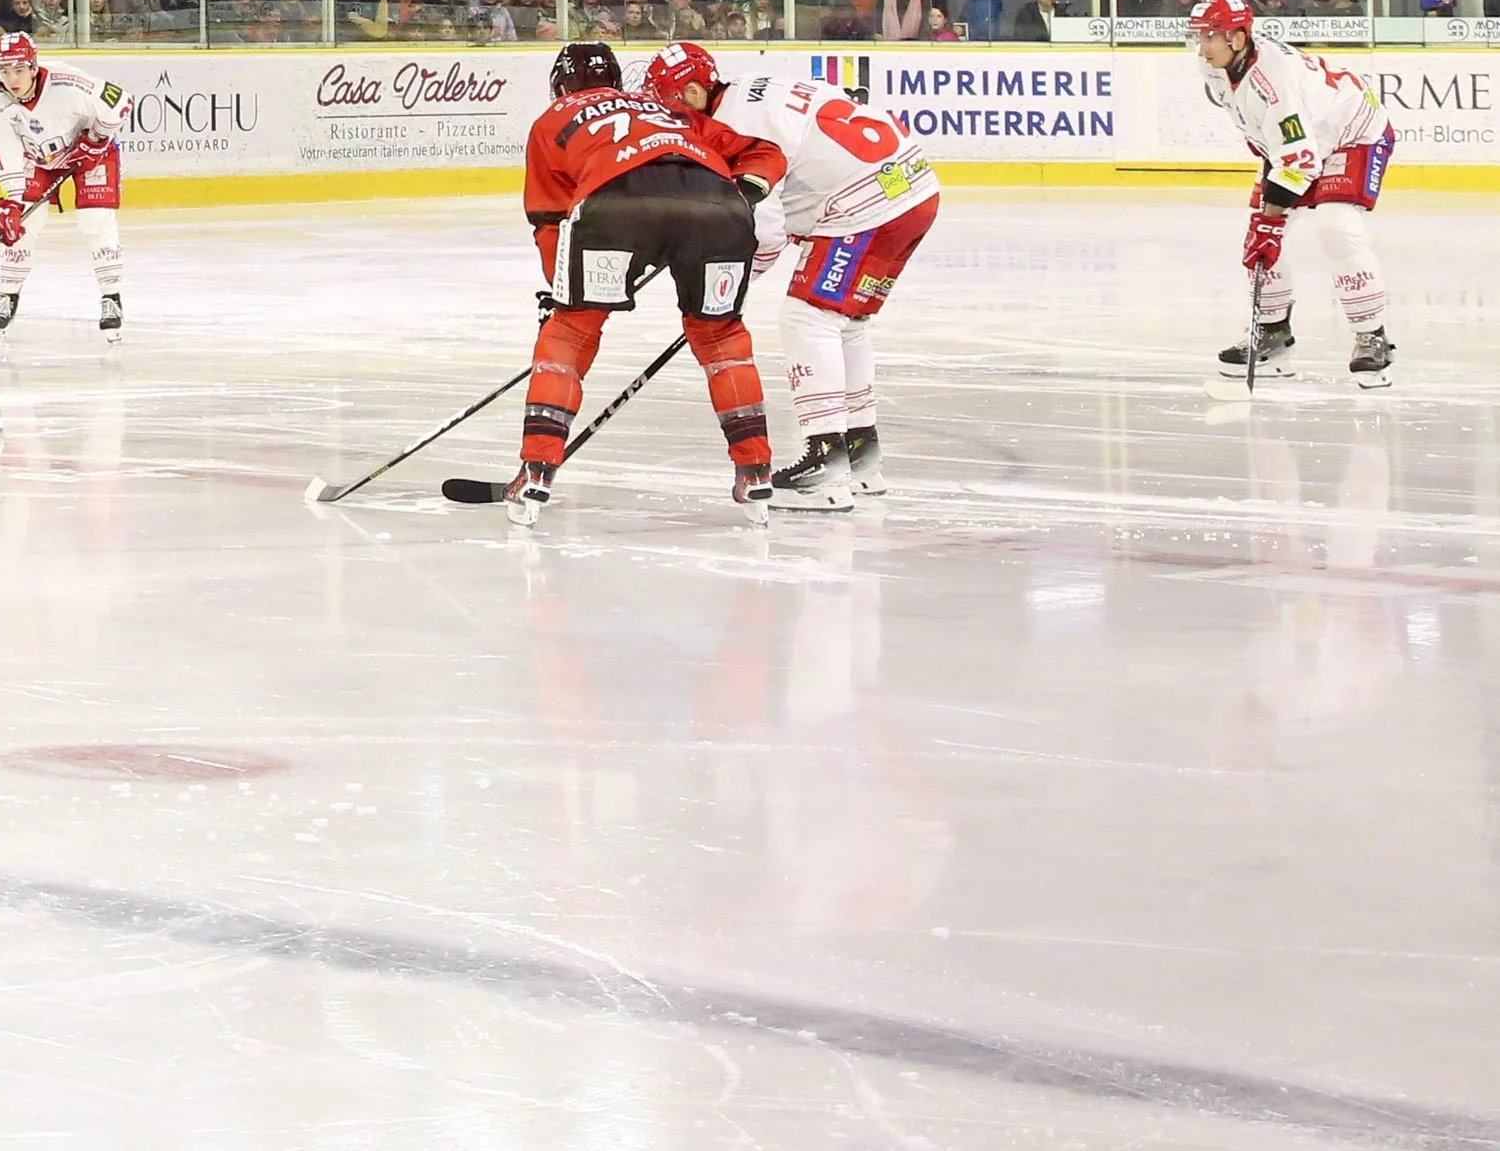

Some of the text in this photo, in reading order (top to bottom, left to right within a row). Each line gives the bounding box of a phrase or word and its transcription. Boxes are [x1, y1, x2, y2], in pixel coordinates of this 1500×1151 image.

[1289, 29, 1369, 39] NATURAL RESORT
[316, 64, 382, 107] Casa
[393, 61, 507, 110] Valerio
[885, 69, 1113, 97] IMPRIMERIE
[1377, 72, 1493, 111] RME
[330, 121, 408, 140] Ristorante
[437, 119, 496, 137] Pizzeria
[815, 98, 908, 164] 6
[886, 109, 1114, 138] MONTERRAIN
[161, 138, 229, 152] SAVOYARD
[412, 147, 428, 157] rue
[431, 144, 443, 156] du
[477, 141, 525, 155] Chamonix
[1369, 156, 1383, 193] RENT
[1256, 224, 1285, 236] CC
[596, 256, 620, 272] QC
[821, 246, 852, 293] RENT
[586, 271, 624, 285] TERM
